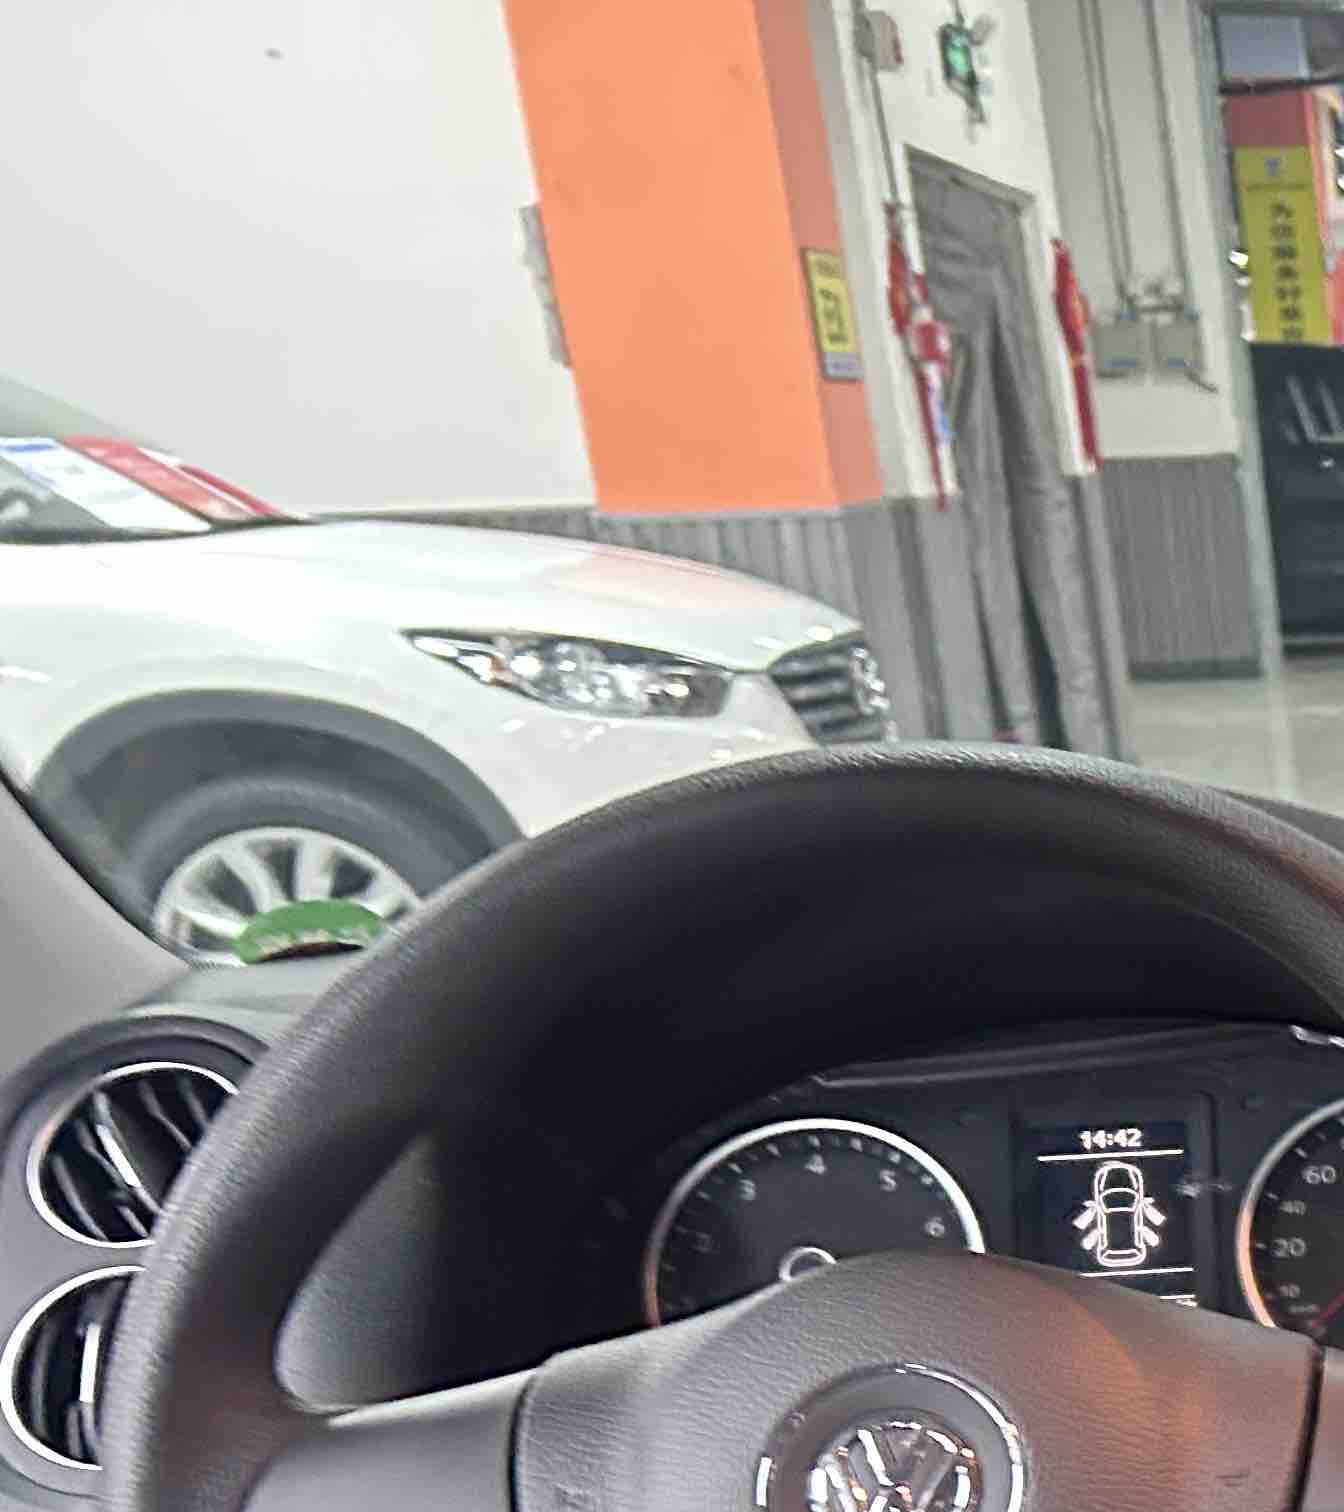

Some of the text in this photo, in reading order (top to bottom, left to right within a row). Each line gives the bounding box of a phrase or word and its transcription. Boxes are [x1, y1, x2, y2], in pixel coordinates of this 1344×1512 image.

[1080, 1127, 1144, 1150] 14:42
[804, 1153, 826, 1175] 4
[880, 1169, 897, 1193] 5
[1303, 1166, 1338, 1185] 60
[738, 1179, 757, 1201] 3
[925, 1216, 946, 1238] 6
[1273, 1237, 1307, 1257] 20
